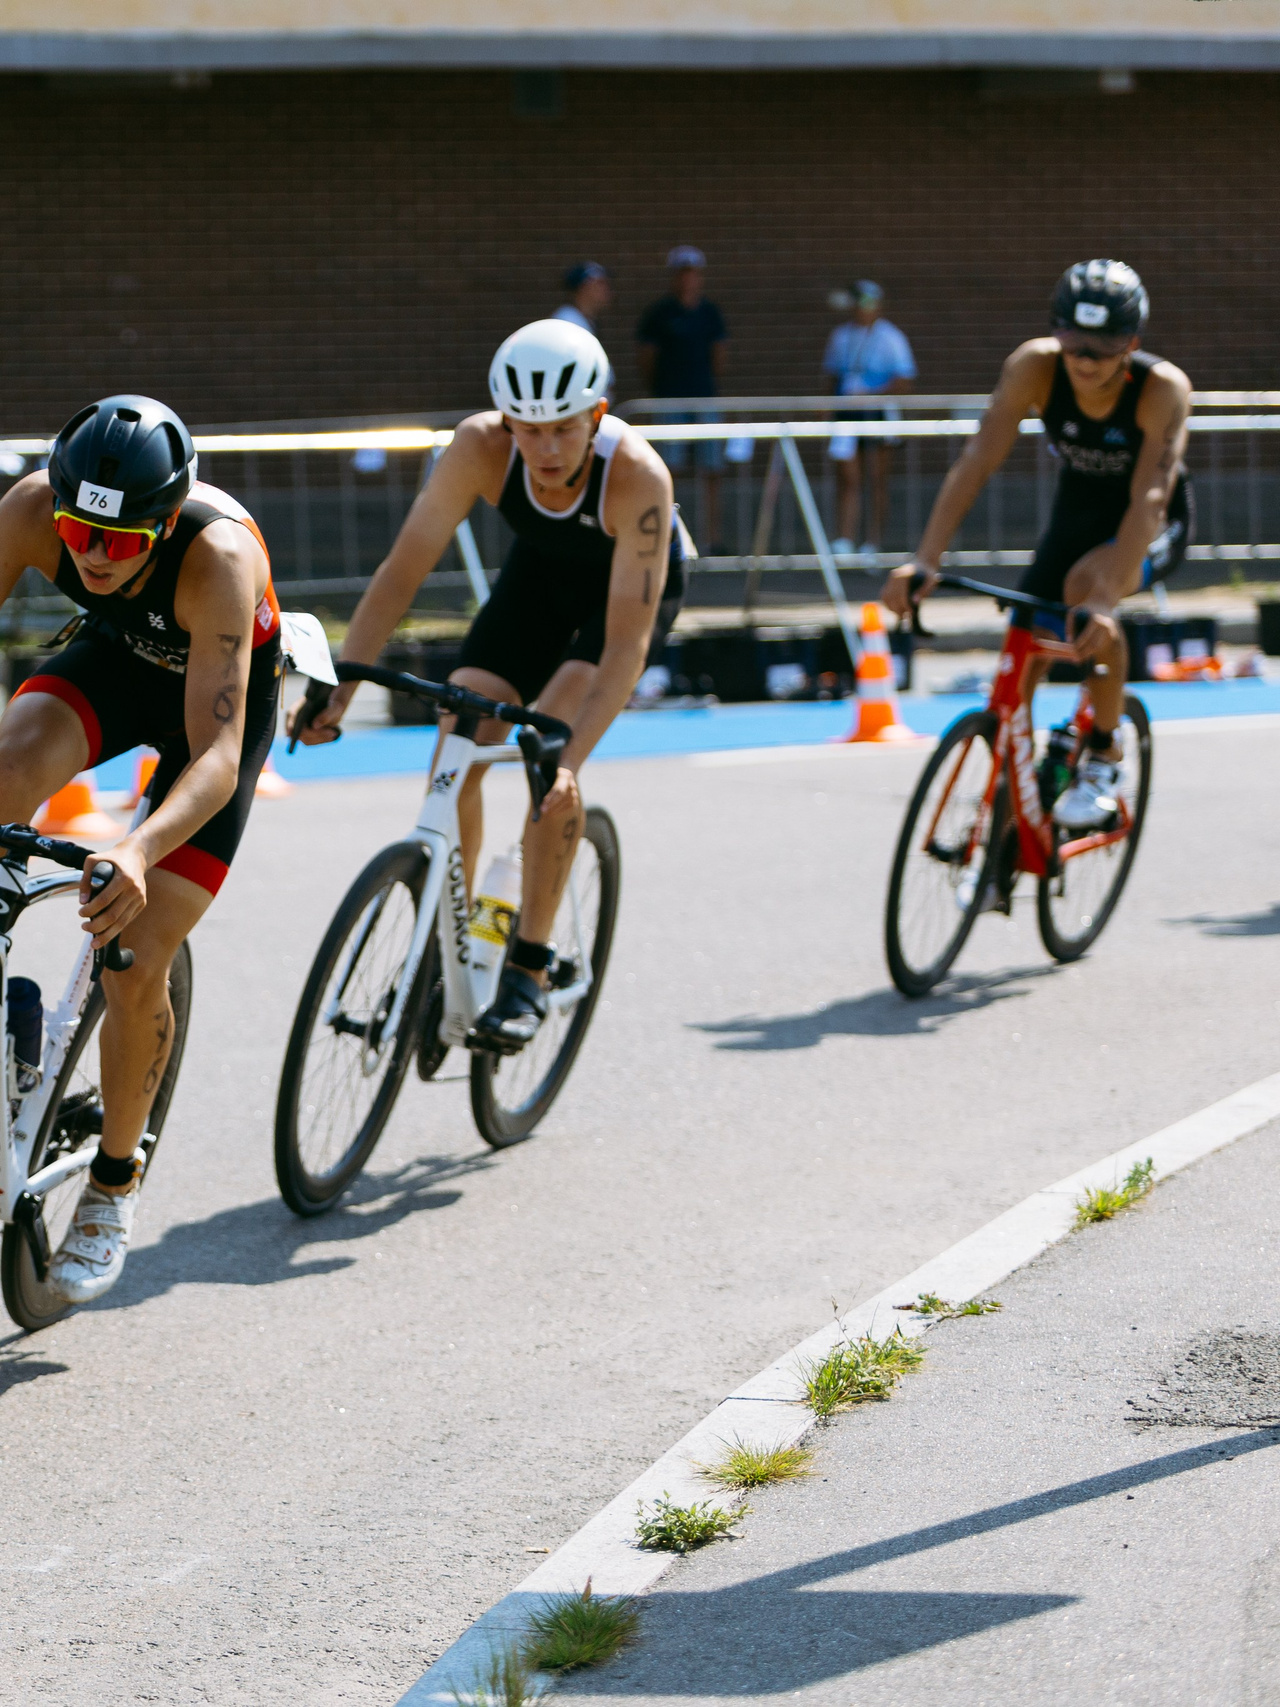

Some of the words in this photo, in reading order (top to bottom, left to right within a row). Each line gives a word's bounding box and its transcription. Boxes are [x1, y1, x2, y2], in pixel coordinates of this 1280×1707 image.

[529, 404, 546, 417] 91
[89, 490, 108, 510] 76
[637, 505, 661, 605] 91
